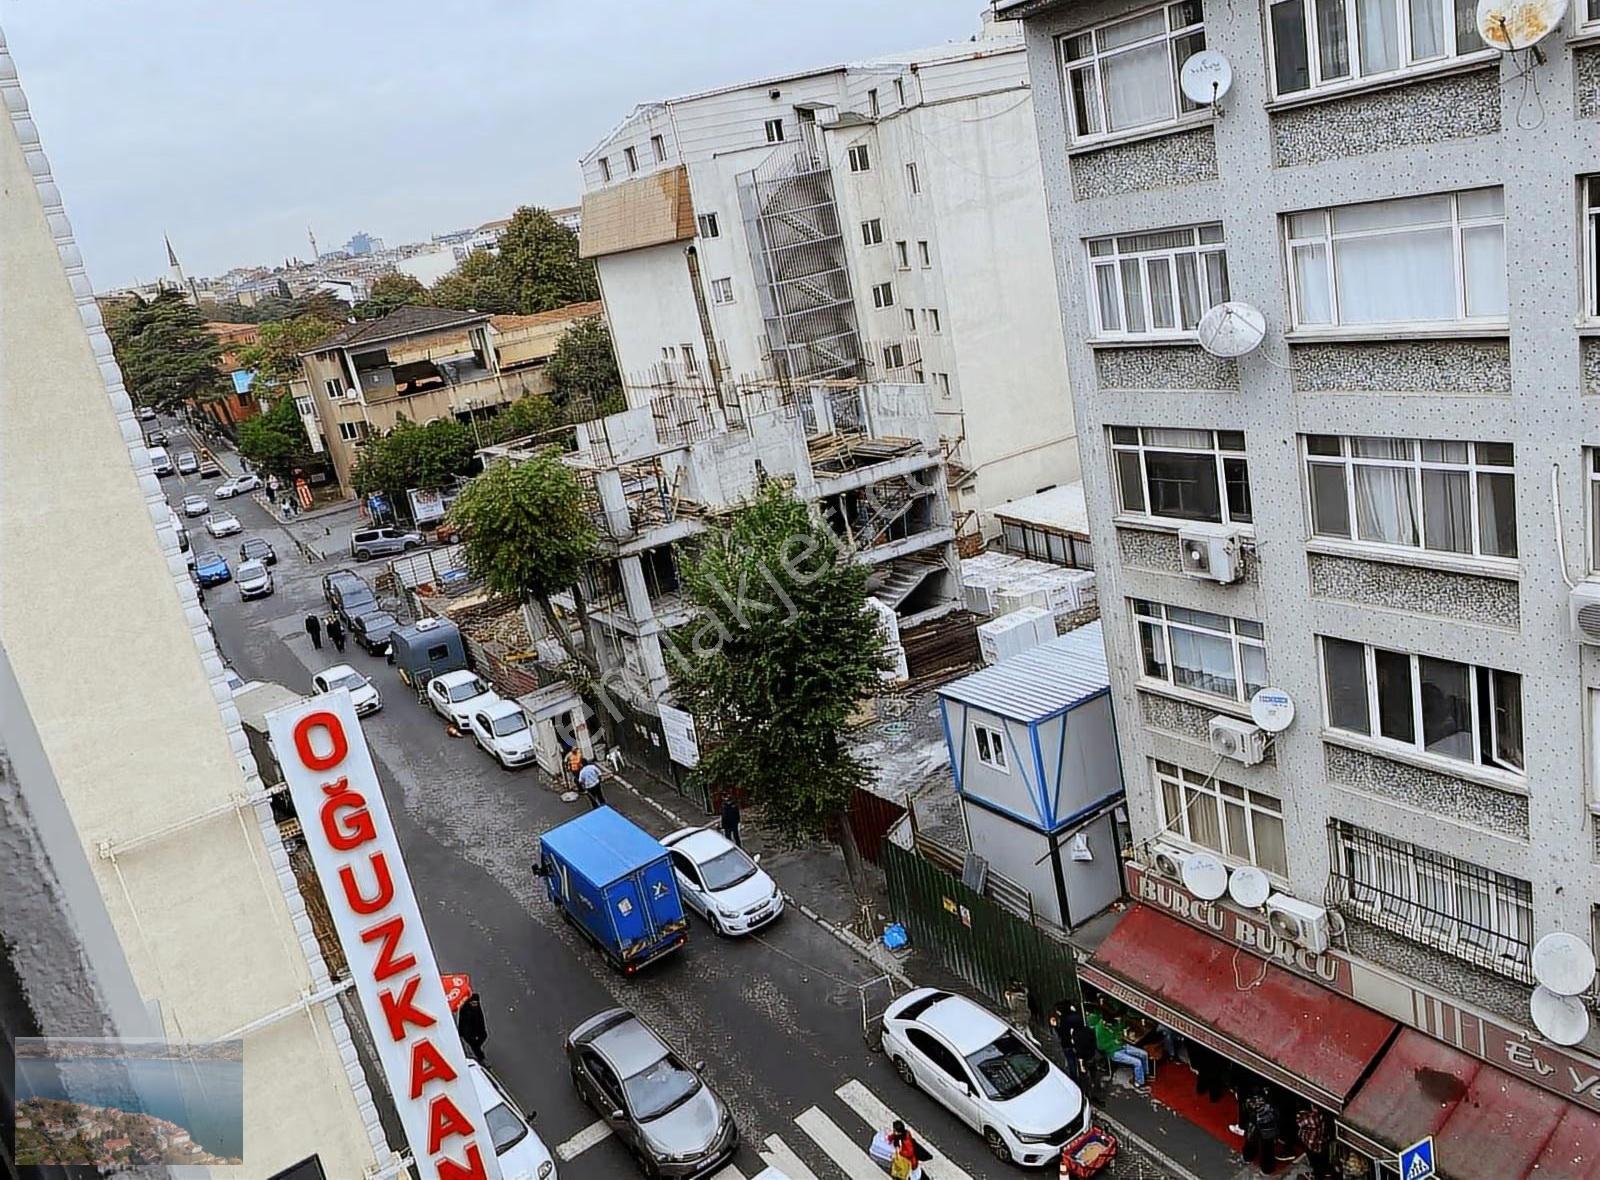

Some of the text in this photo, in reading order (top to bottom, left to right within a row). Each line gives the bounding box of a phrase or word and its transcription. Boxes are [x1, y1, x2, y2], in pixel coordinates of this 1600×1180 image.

[293, 711, 488, 1180] OĞUZKAAN
[1139, 876, 1339, 982] BURCU BURCU
